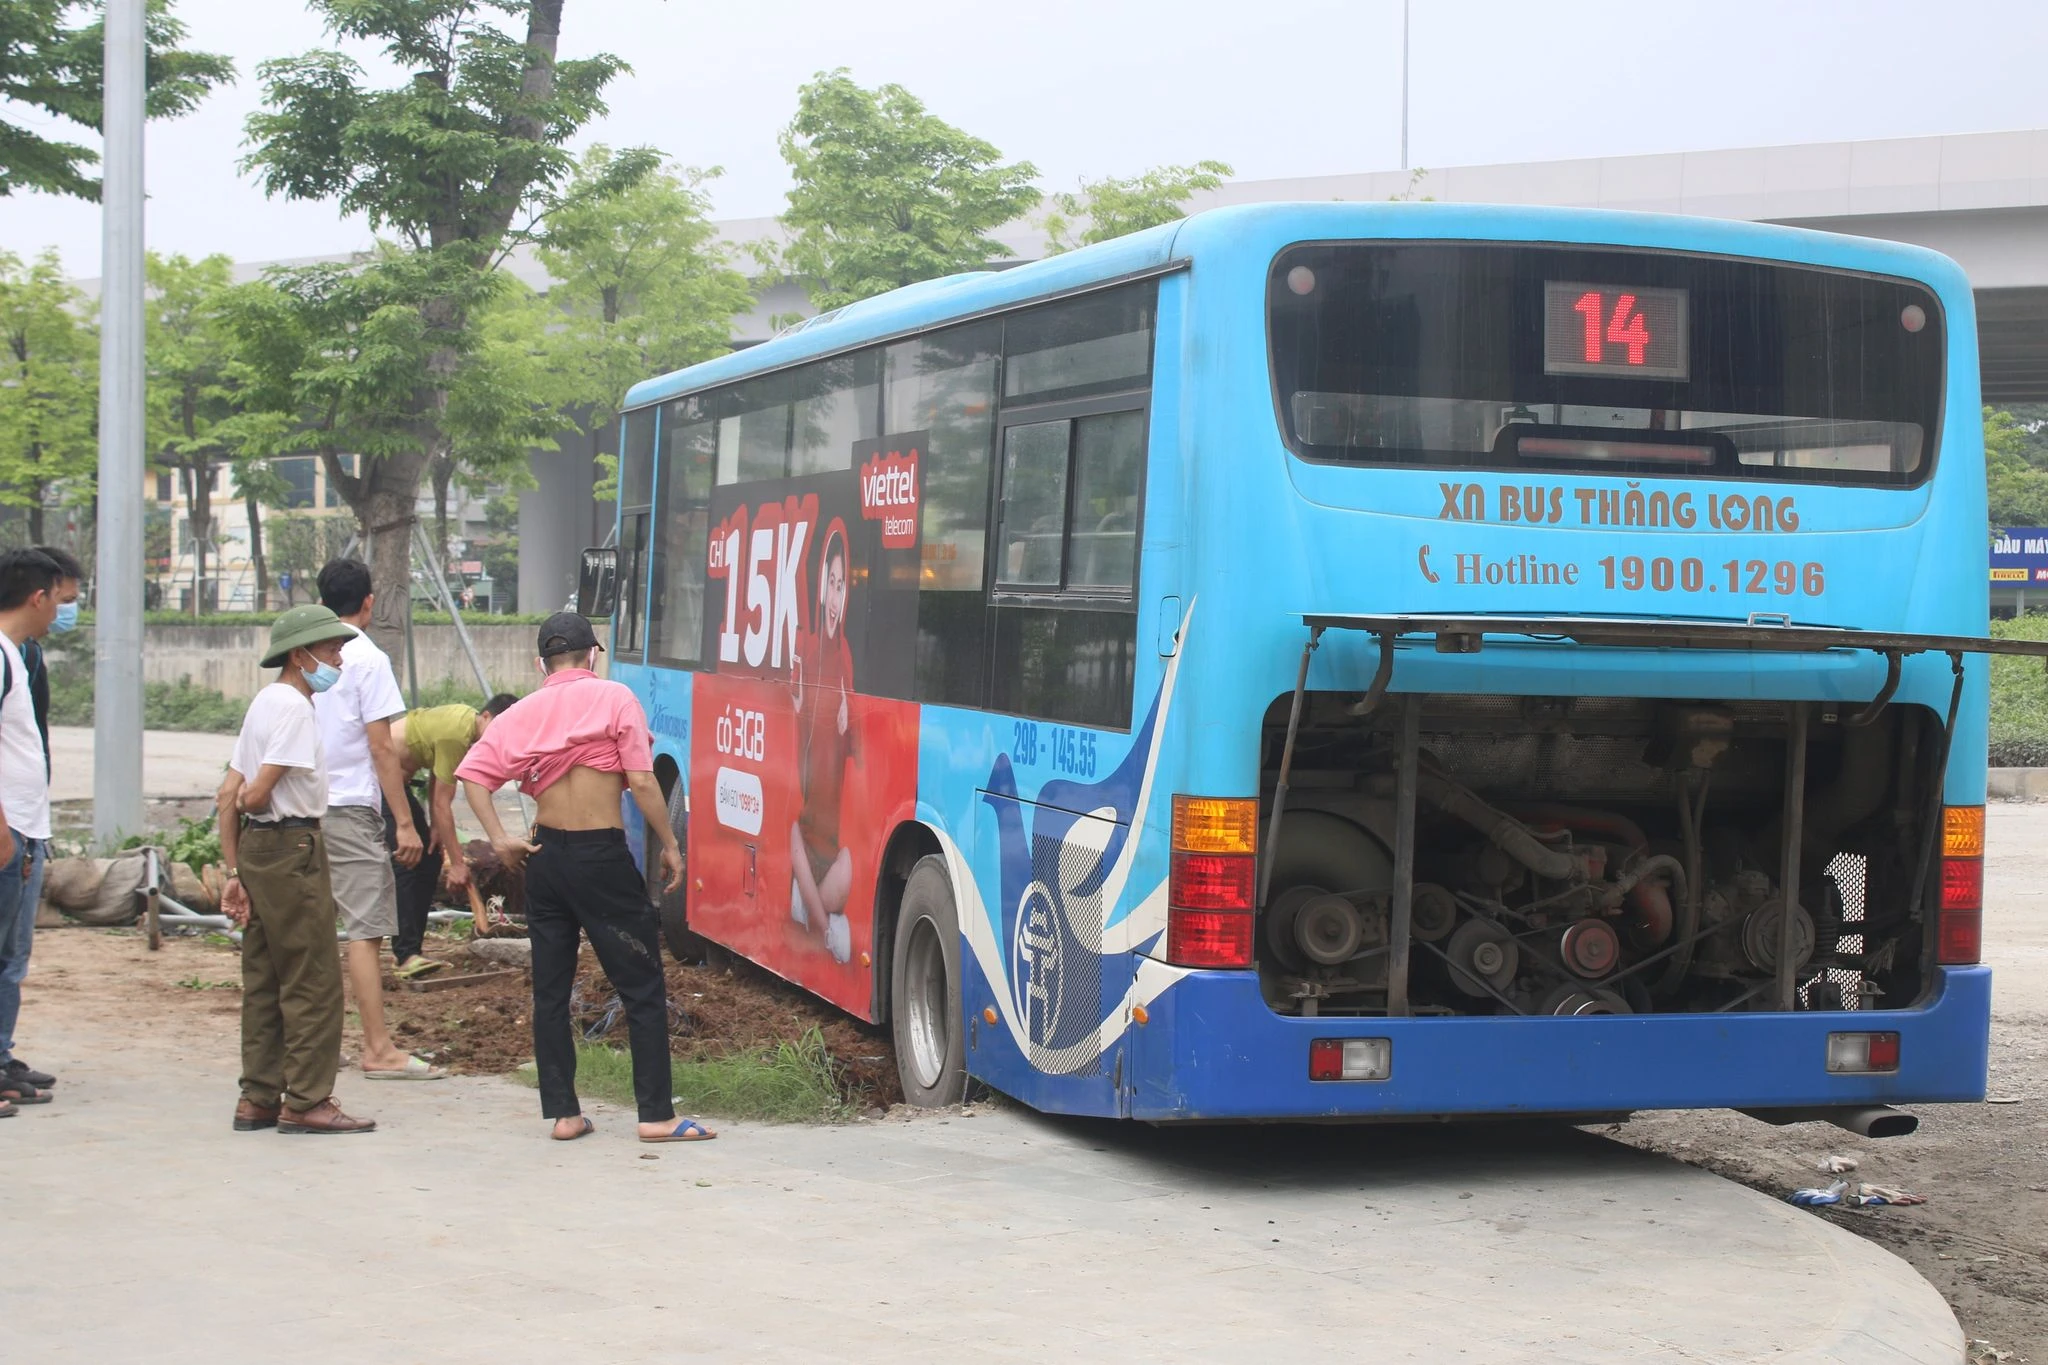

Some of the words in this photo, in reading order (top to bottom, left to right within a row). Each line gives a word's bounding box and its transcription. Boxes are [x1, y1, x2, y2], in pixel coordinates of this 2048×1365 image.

[1575, 292, 1649, 365] 14
[863, 463, 915, 507] viettel
[1499, 485, 1564, 523] BUS
[1574, 481, 1697, 528] THĂNG
[1708, 494, 1799, 532] LONG
[884, 516, 914, 536] telecom
[720, 521, 808, 669] 15K
[1454, 553, 1580, 585] Hotline
[1598, 555, 1825, 597] 1900.1296
[734, 708, 764, 762] 3GB
[1013, 721, 1037, 766] 29B
[1052, 727, 1097, 778] 145.55
